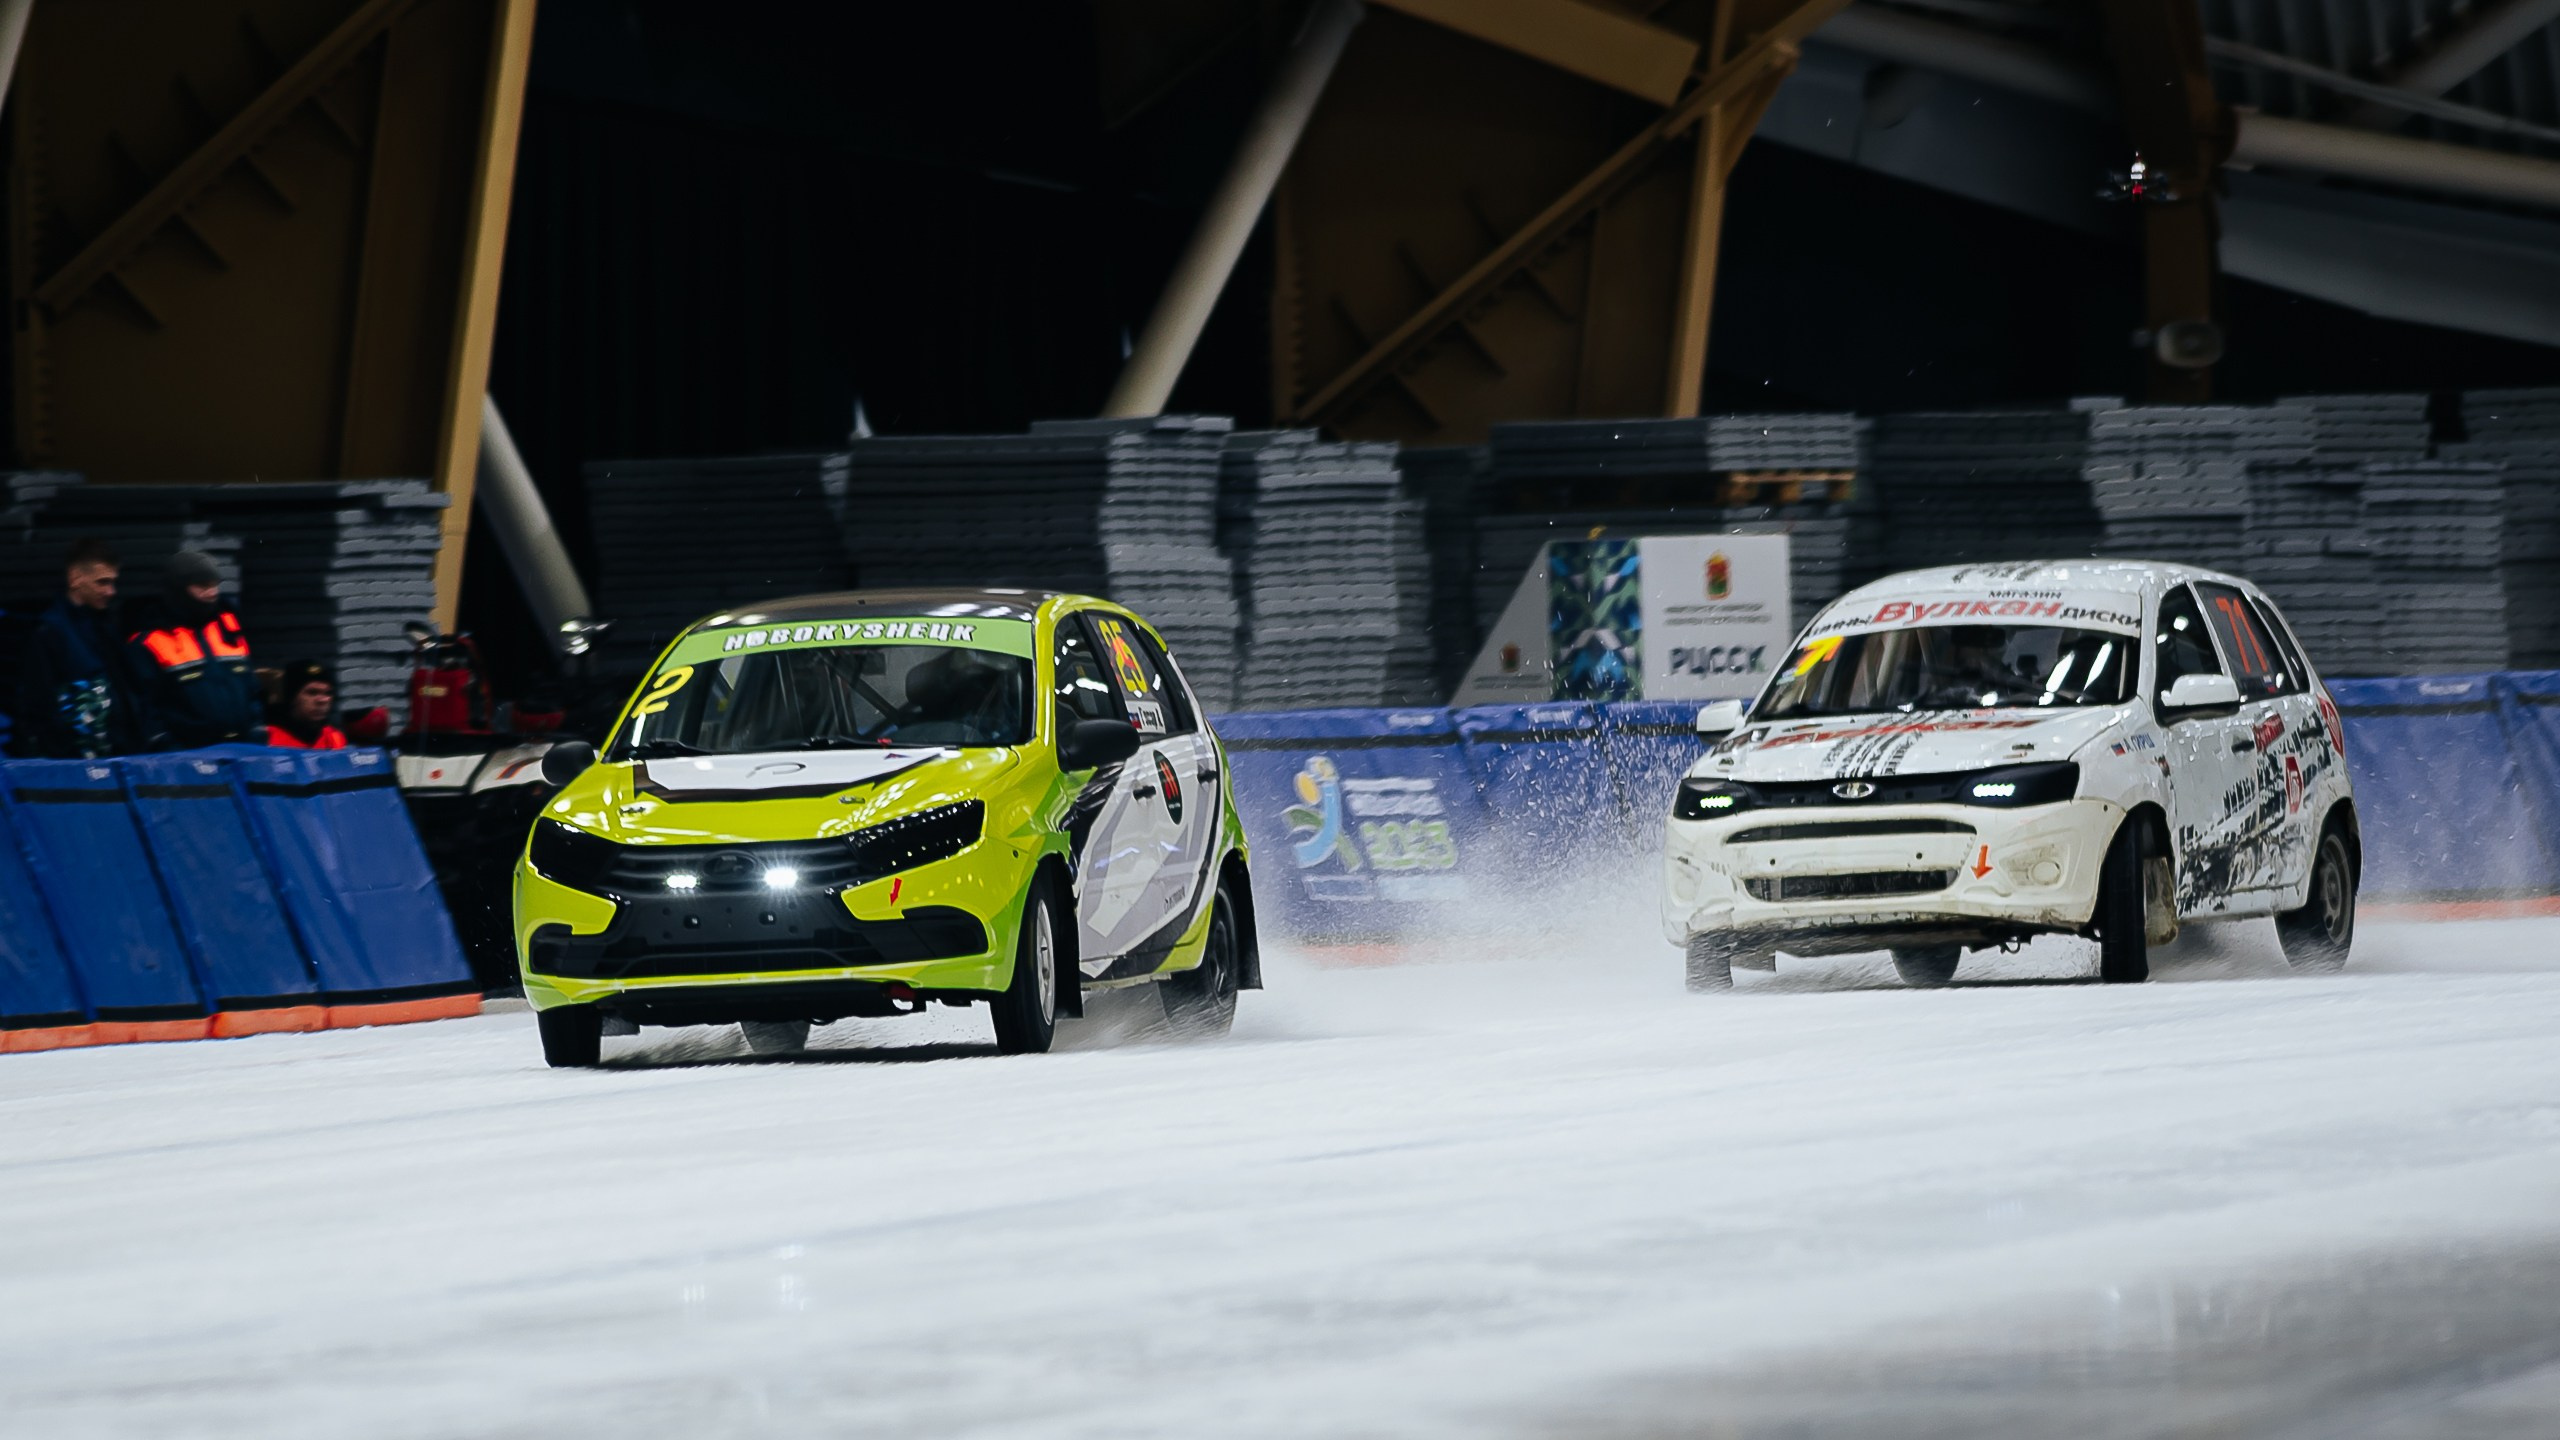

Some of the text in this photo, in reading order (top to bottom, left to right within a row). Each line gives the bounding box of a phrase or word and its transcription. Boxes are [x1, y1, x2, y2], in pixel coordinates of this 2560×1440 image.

[722, 622, 978, 652] НОВОКУЗНЕЦК
[1098, 619, 1149, 693] 25
[1669, 645, 1767, 680] РЦССК
[2215, 596, 2268, 675] 71
[631, 665, 694, 719] 2
